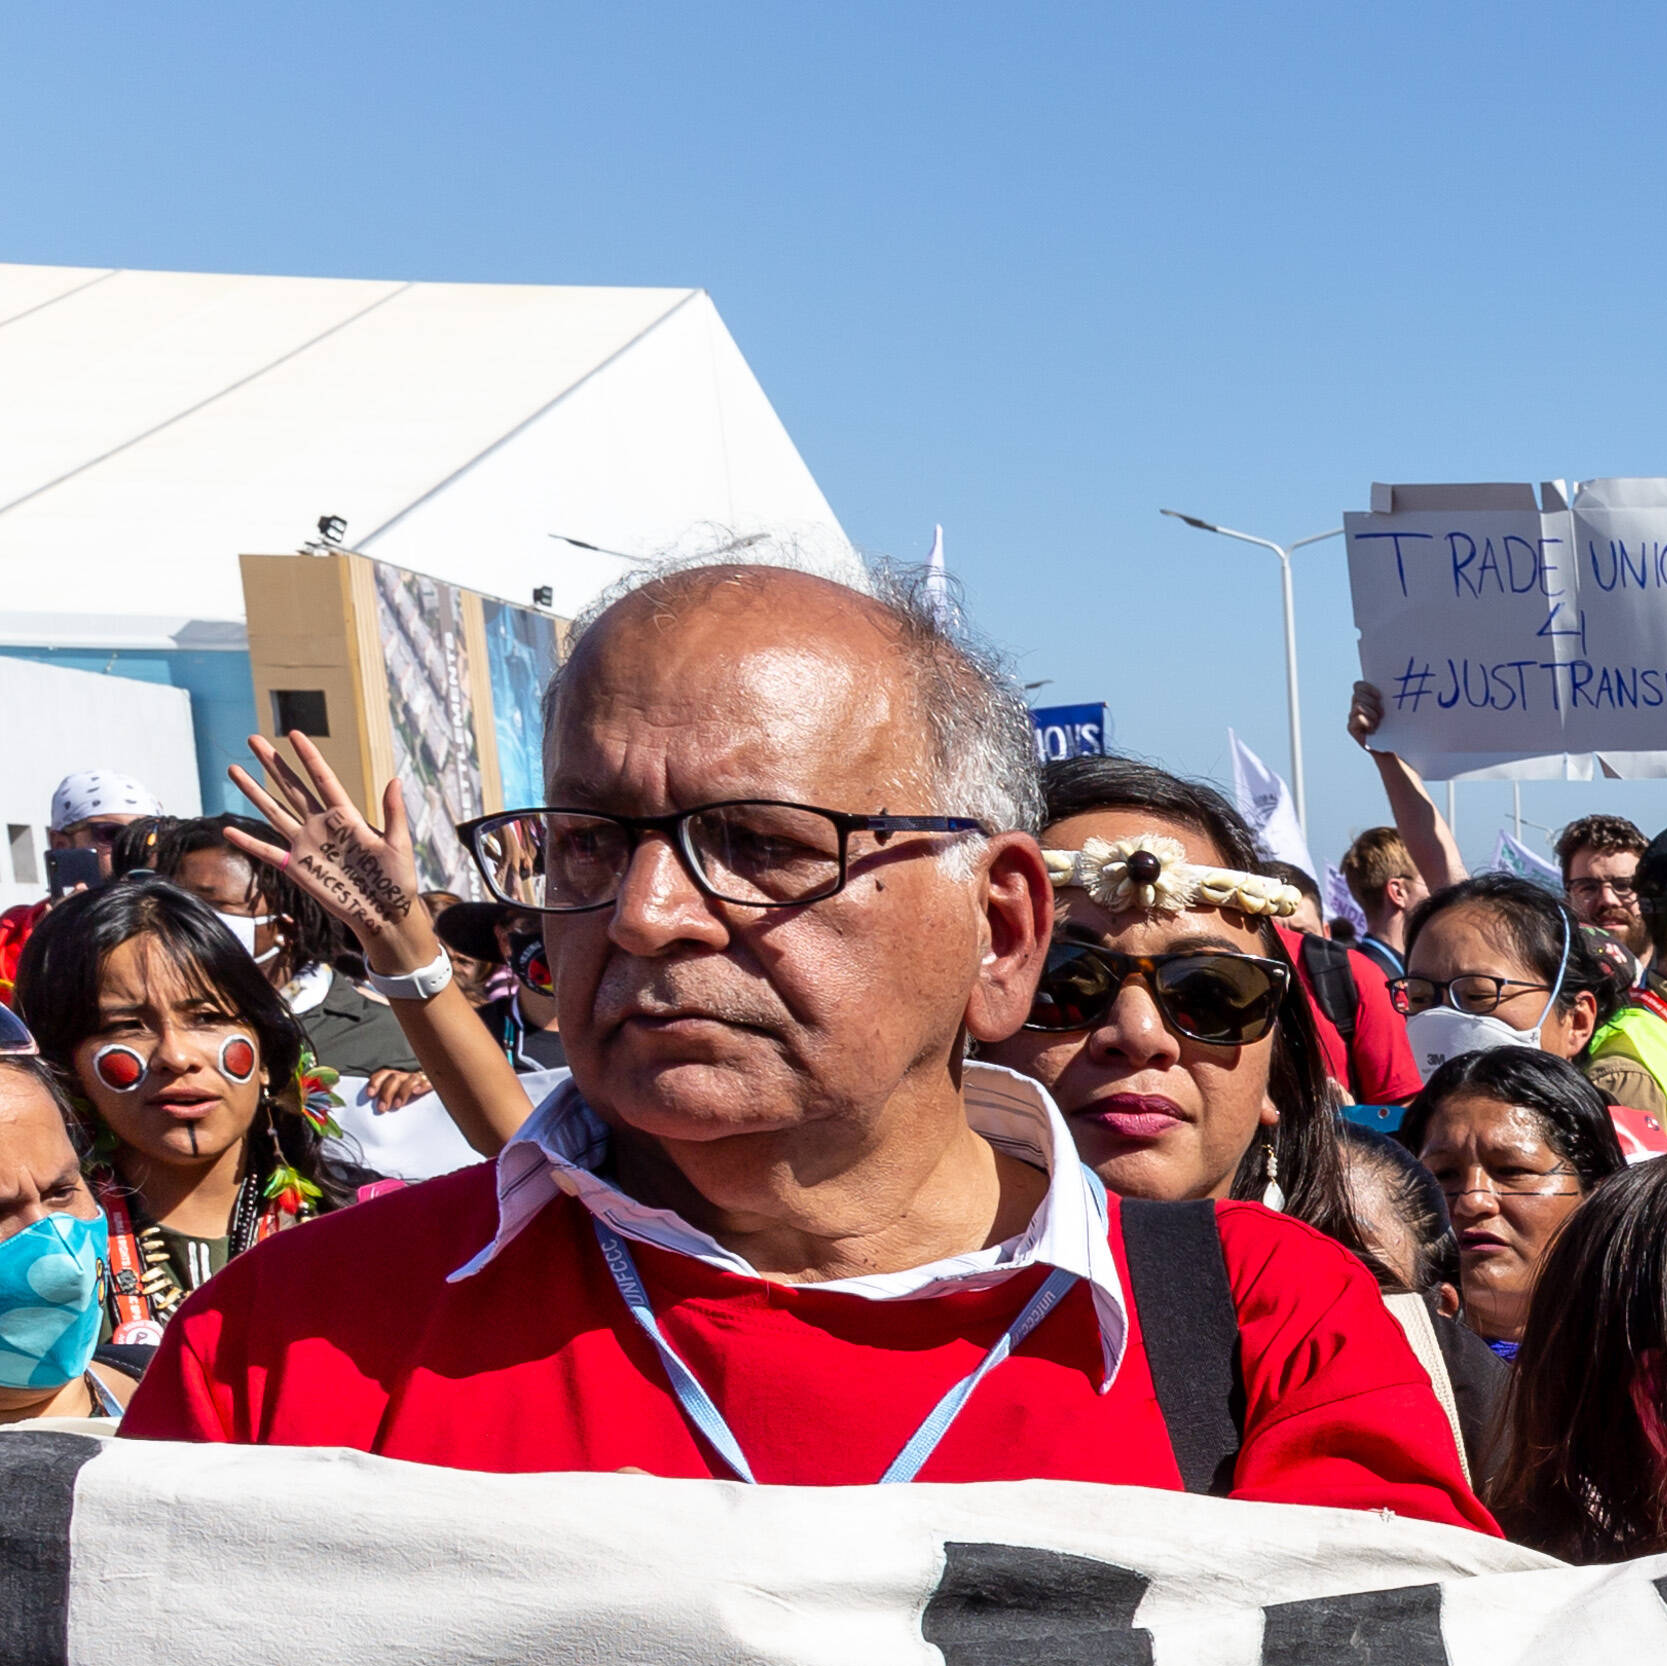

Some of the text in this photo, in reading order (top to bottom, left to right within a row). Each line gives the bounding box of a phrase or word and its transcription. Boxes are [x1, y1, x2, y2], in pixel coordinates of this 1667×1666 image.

[1355, 531, 1567, 599] TRADE
[1536, 602, 1587, 656] 4
[319, 842, 340, 863] de
[325, 810, 412, 918] EN MEMORIA
[298, 854, 383, 937] ANCESTROS
[1427, 1053, 1445, 1066] 3M
[601, 1239, 645, 1306] UNFCCC
